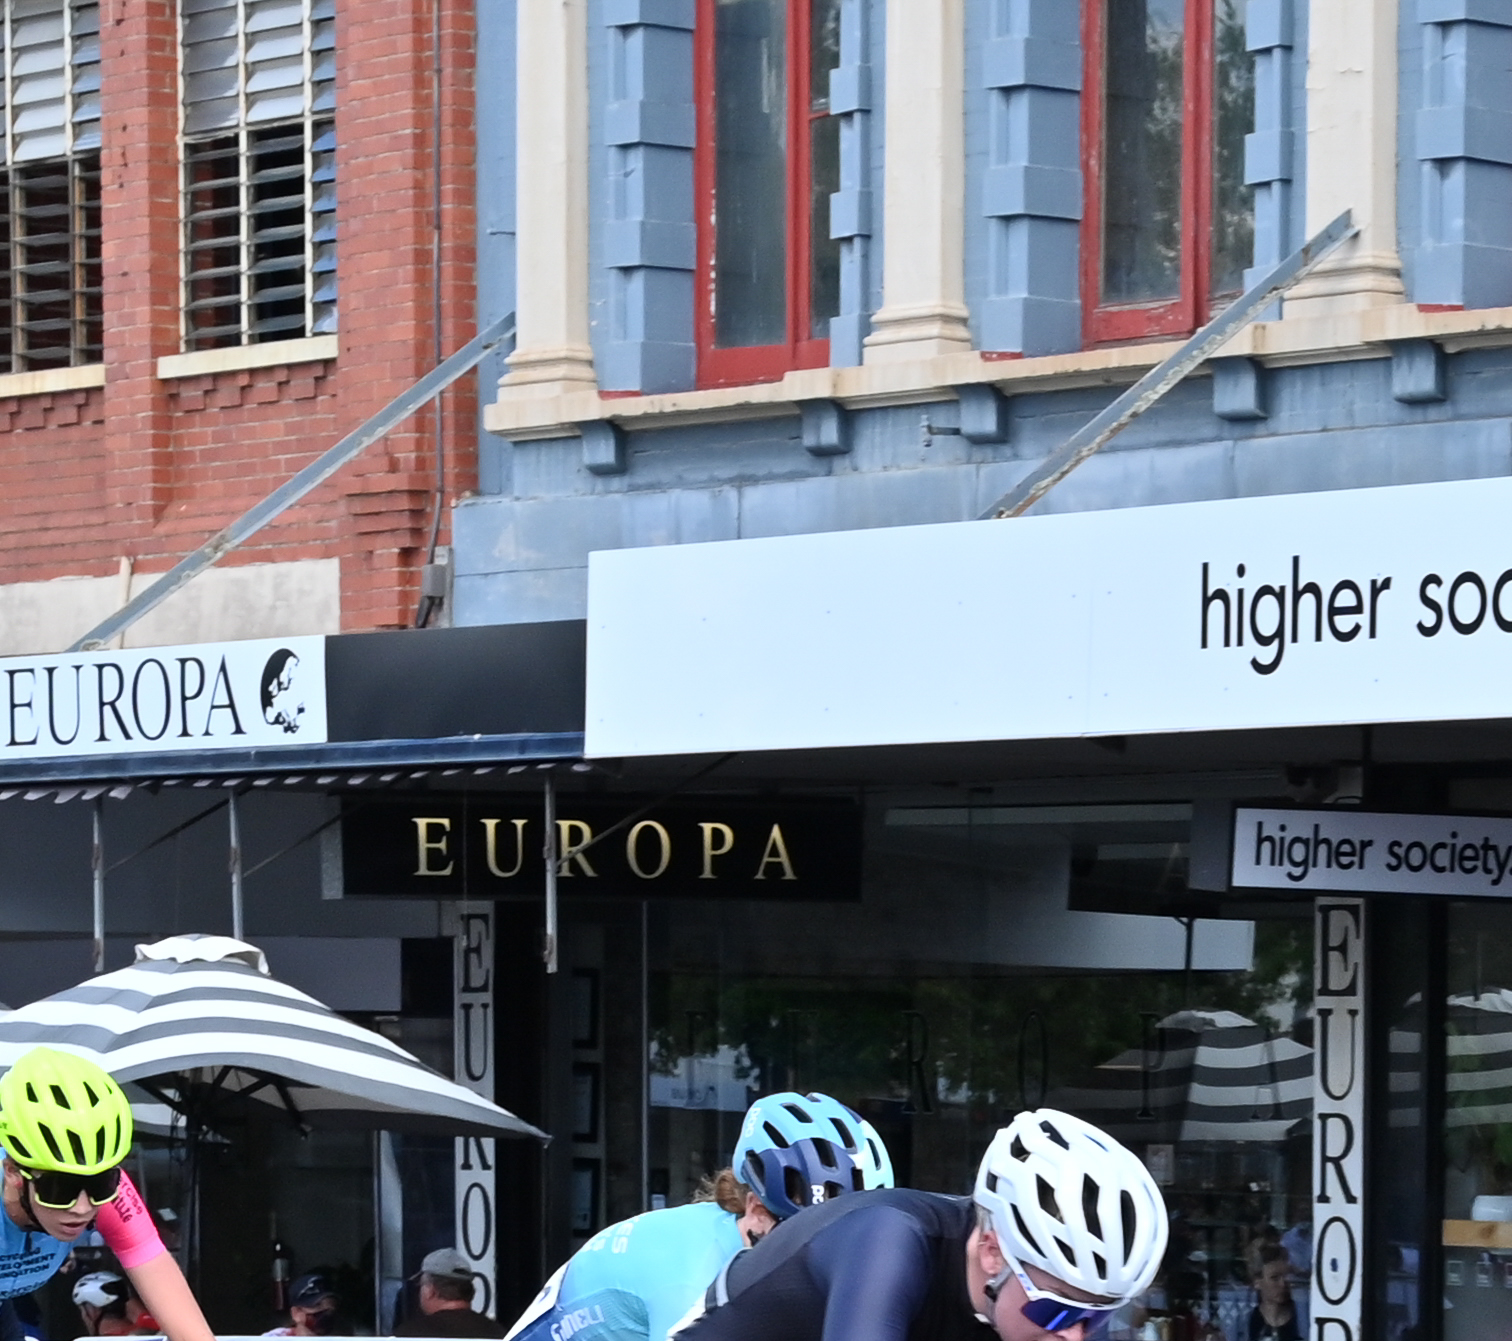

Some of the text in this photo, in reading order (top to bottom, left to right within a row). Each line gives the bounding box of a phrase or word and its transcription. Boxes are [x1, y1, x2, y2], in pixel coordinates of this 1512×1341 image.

[1200, 555, 1392, 676] higher
[4, 652, 246, 748] EUROPA
[412, 816, 799, 880] EUROPA
[1253, 819, 1376, 882] higher
